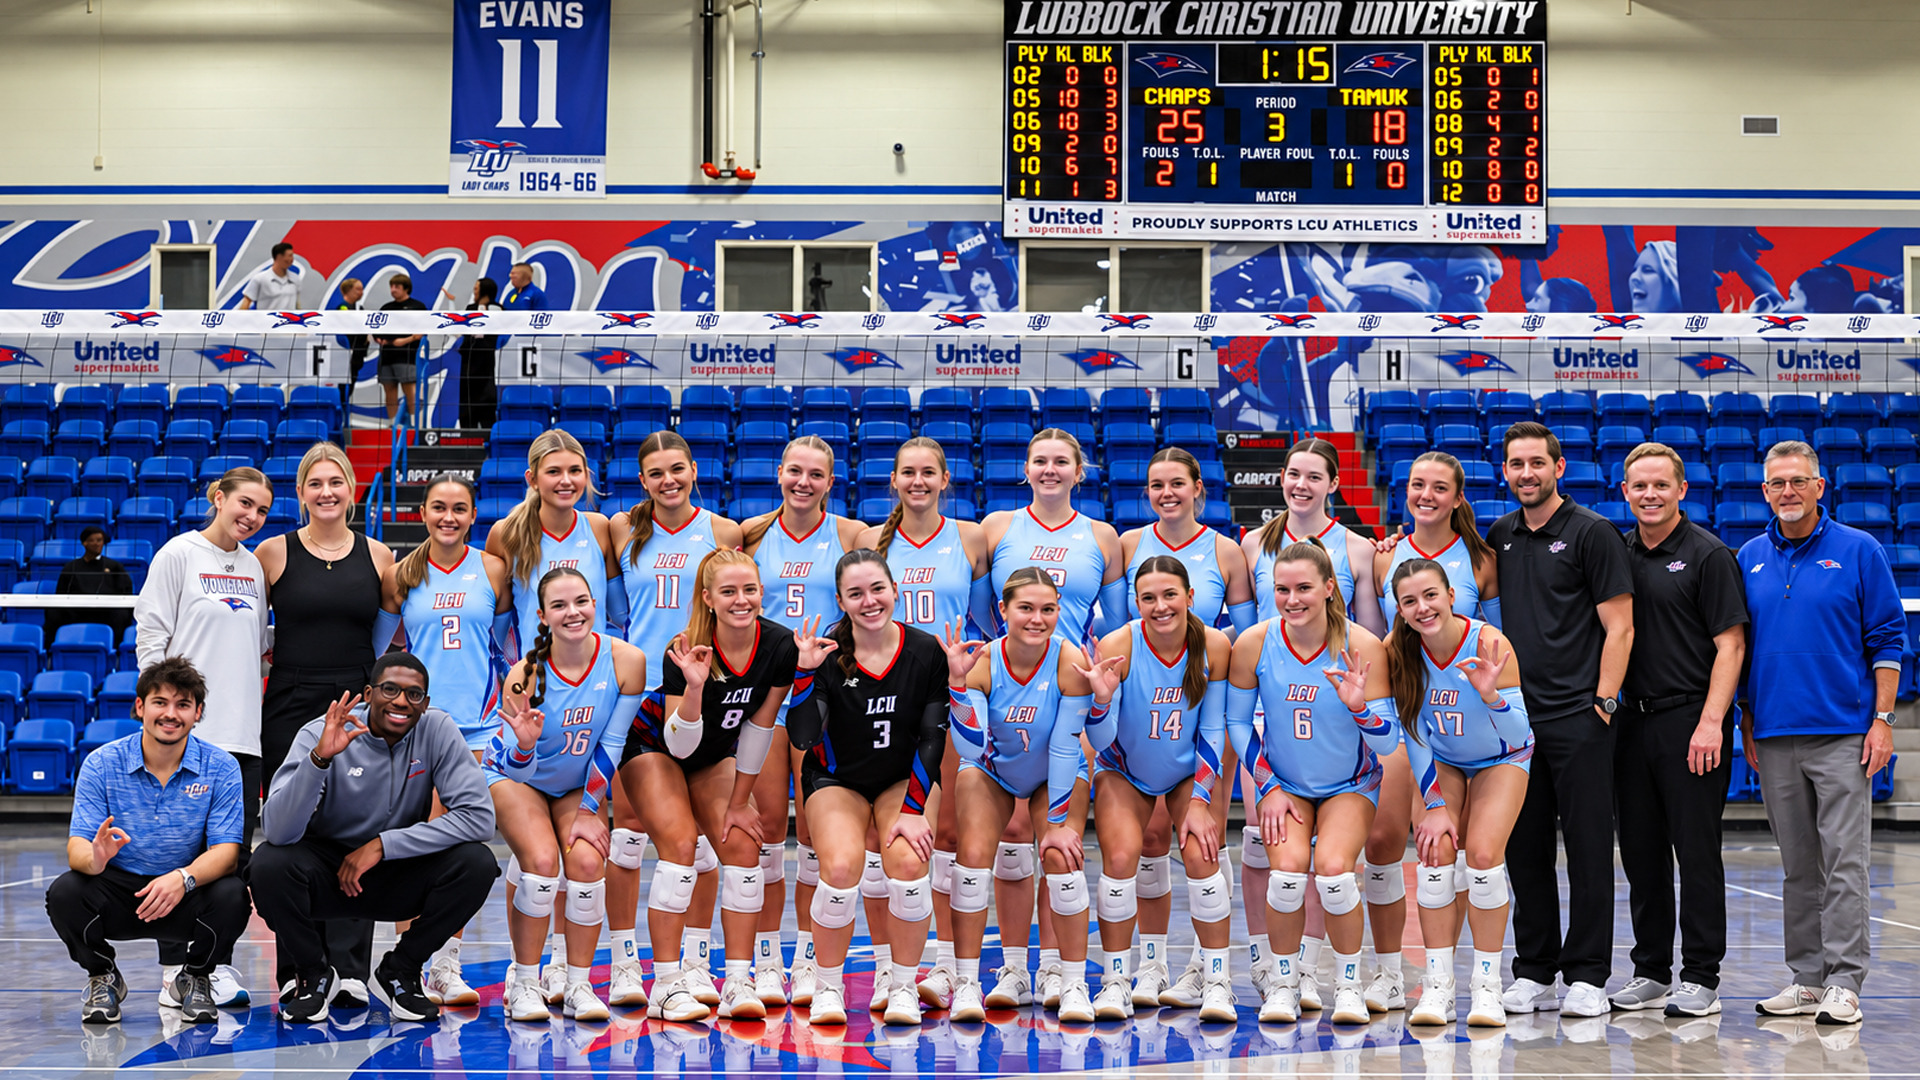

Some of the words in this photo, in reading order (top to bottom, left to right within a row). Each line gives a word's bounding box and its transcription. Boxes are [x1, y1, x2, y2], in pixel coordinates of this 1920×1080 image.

[479, 1, 584, 29] EVANS
[1013, 1, 1171, 35] LUBBOCK
[1175, 1, 1342, 35] CHRISTIAN
[1349, 1, 1538, 35] UNIVERSITY
[1018, 45, 1048, 63] PLY
[1056, 45, 1076, 63] KL
[1082, 45, 1112, 63] BLK
[1262, 46, 1330, 81] 1:15
[1439, 45, 1469, 63] PLY
[1476, 45, 1497, 63] KL
[1503, 45, 1532, 63] BLK
[495, 39, 563, 128] 11
[1013, 65, 1041, 85] 02
[1065, 65, 1080, 86] 0
[1103, 65, 1118, 86] 0
[1434, 66, 1462, 87] 05
[1486, 66, 1501, 87] 0
[1532, 67, 1539, 86] 1
[1013, 88, 1041, 108] 05
[1059, 87, 1080, 109] 10
[1105, 88, 1118, 109] 3
[1144, 87, 1211, 105] CHAPS
[1255, 96, 1297, 109] PERIOD
[1339, 88, 1409, 106] TAMUK
[1435, 90, 1463, 110] 06
[1487, 89, 1502, 110] 2
[1524, 89, 1539, 111] 0
[1013, 111, 1041, 131] 06
[1058, 111, 1079, 132] 10
[1105, 111, 1118, 132] 3
[1157, 108, 1204, 144] 25
[1268, 112, 1285, 142] 3
[1373, 109, 1406, 145] 18
[1435, 113, 1463, 133] 08
[1486, 114, 1501, 133] 4
[1532, 114, 1539, 133] 1
[1012, 133, 1041, 153] 09
[1065, 133, 1080, 154] 2
[1103, 134, 1118, 155] 0
[1142, 146, 1180, 159] FOULS
[1192, 147, 1225, 159] T.O.L.
[1240, 147, 1281, 160] PLAYER
[1286, 147, 1315, 160] FOUL
[1328, 148, 1361, 160] T.O.L.
[1373, 148, 1410, 160] FOULS
[1434, 136, 1463, 157] 09
[1487, 136, 1502, 157] 2
[1524, 136, 1539, 157] 2
[467, 149, 512, 177] LCU
[1020, 155, 1041, 175] 10
[1065, 155, 1079, 176] 6
[1105, 156, 1118, 176] 7
[1155, 159, 1174, 186] 2
[1442, 160, 1463, 180] 10
[1487, 159, 1502, 180] 8
[1524, 159, 1539, 181] 0
[519, 172, 597, 191] 1964-66
[1210, 162, 1217, 186] 1
[1346, 162, 1353, 187] 1
[1387, 161, 1405, 189] 0
[461, 180, 482, 191] LADY
[1020, 179, 1041, 196] 11
[1072, 180, 1079, 197] 1
[1105, 179, 1118, 199] 3
[1442, 182, 1463, 202] 12
[1487, 182, 1502, 203] 0
[1524, 183, 1539, 204] 0
[1255, 191, 1297, 203] MATCH
[1028, 207, 1103, 225] United
[1132, 217, 1206, 230] PROUDLY
[1210, 218, 1293, 231] SUPPORTS
[1298, 219, 1328, 231] LCU
[1332, 219, 1418, 232] ATHLETICS
[1446, 213, 1522, 230] United
[74, 341, 160, 361] United
[313, 345, 327, 377] F
[690, 342, 775, 363] United
[936, 343, 1021, 364] United
[1553, 347, 1638, 368] United
[1777, 349, 1861, 370] United
[521, 346, 537, 378] G
[1177, 348, 1193, 379] G
[1386, 350, 1401, 381] H
[654, 553, 688, 569] LCU
[1029, 545, 1069, 562] LCU
[780, 562, 813, 578] LCU
[902, 567, 936, 584] LCU
[433, 592, 466, 609] LCU
[655, 575, 680, 609] 11
[786, 584, 805, 617] 5
[904, 590, 935, 624] 10
[441, 615, 461, 650] 2
[721, 687, 754, 705] LCU
[1152, 687, 1183, 704] LCU
[1285, 684, 1319, 703] LCU
[1429, 689, 1459, 707] LCU
[865, 695, 898, 715] LCU
[1004, 705, 1037, 724] LCU
[562, 706, 595, 728] LCU
[720, 709, 744, 730] 8
[1148, 710, 1182, 740] 14
[1293, 708, 1313, 740] 6
[1432, 711, 1464, 737] 17
[873, 720, 892, 749] 3
